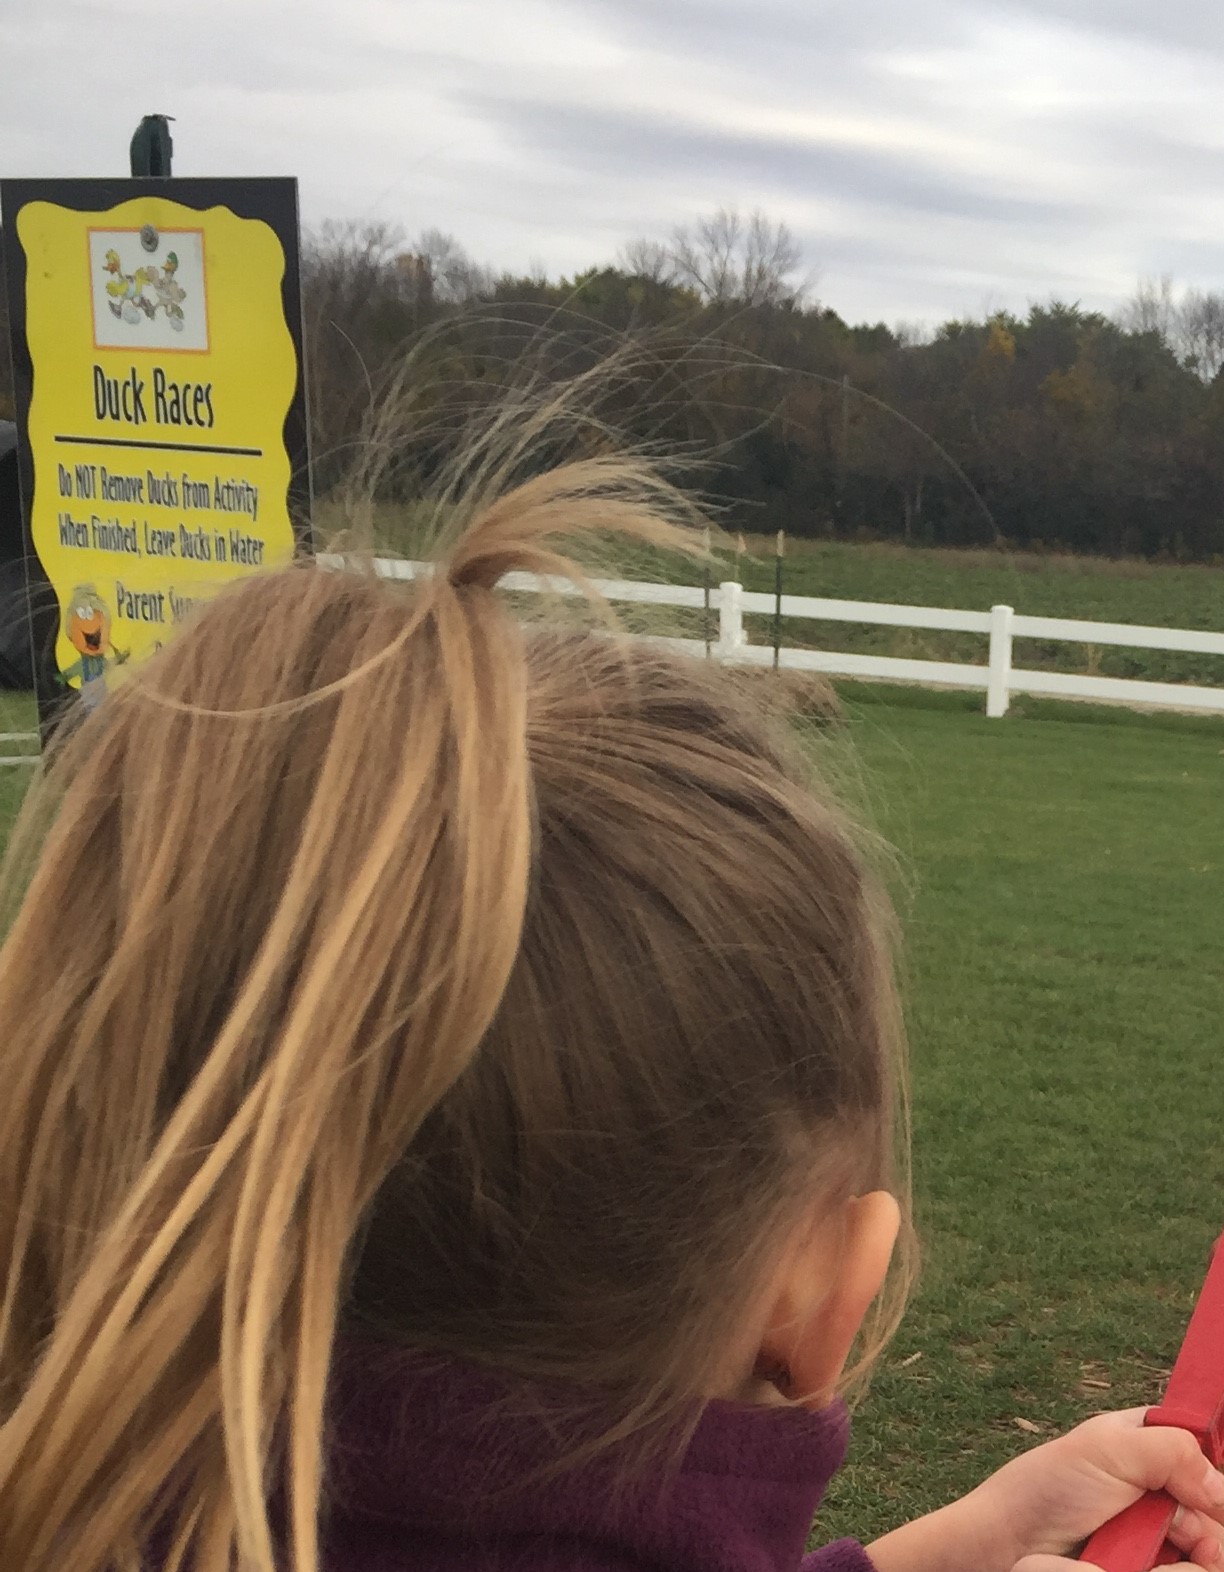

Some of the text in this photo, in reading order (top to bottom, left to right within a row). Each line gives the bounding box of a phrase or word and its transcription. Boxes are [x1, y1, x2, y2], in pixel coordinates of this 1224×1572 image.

[93, 364, 214, 428] Duck Races
[58, 463, 259, 522] Do NOT Remove Ducks from Activity
[58, 513, 264, 565] When Finished, Leave Ducks in Water
[116, 580, 165, 623] Parent
